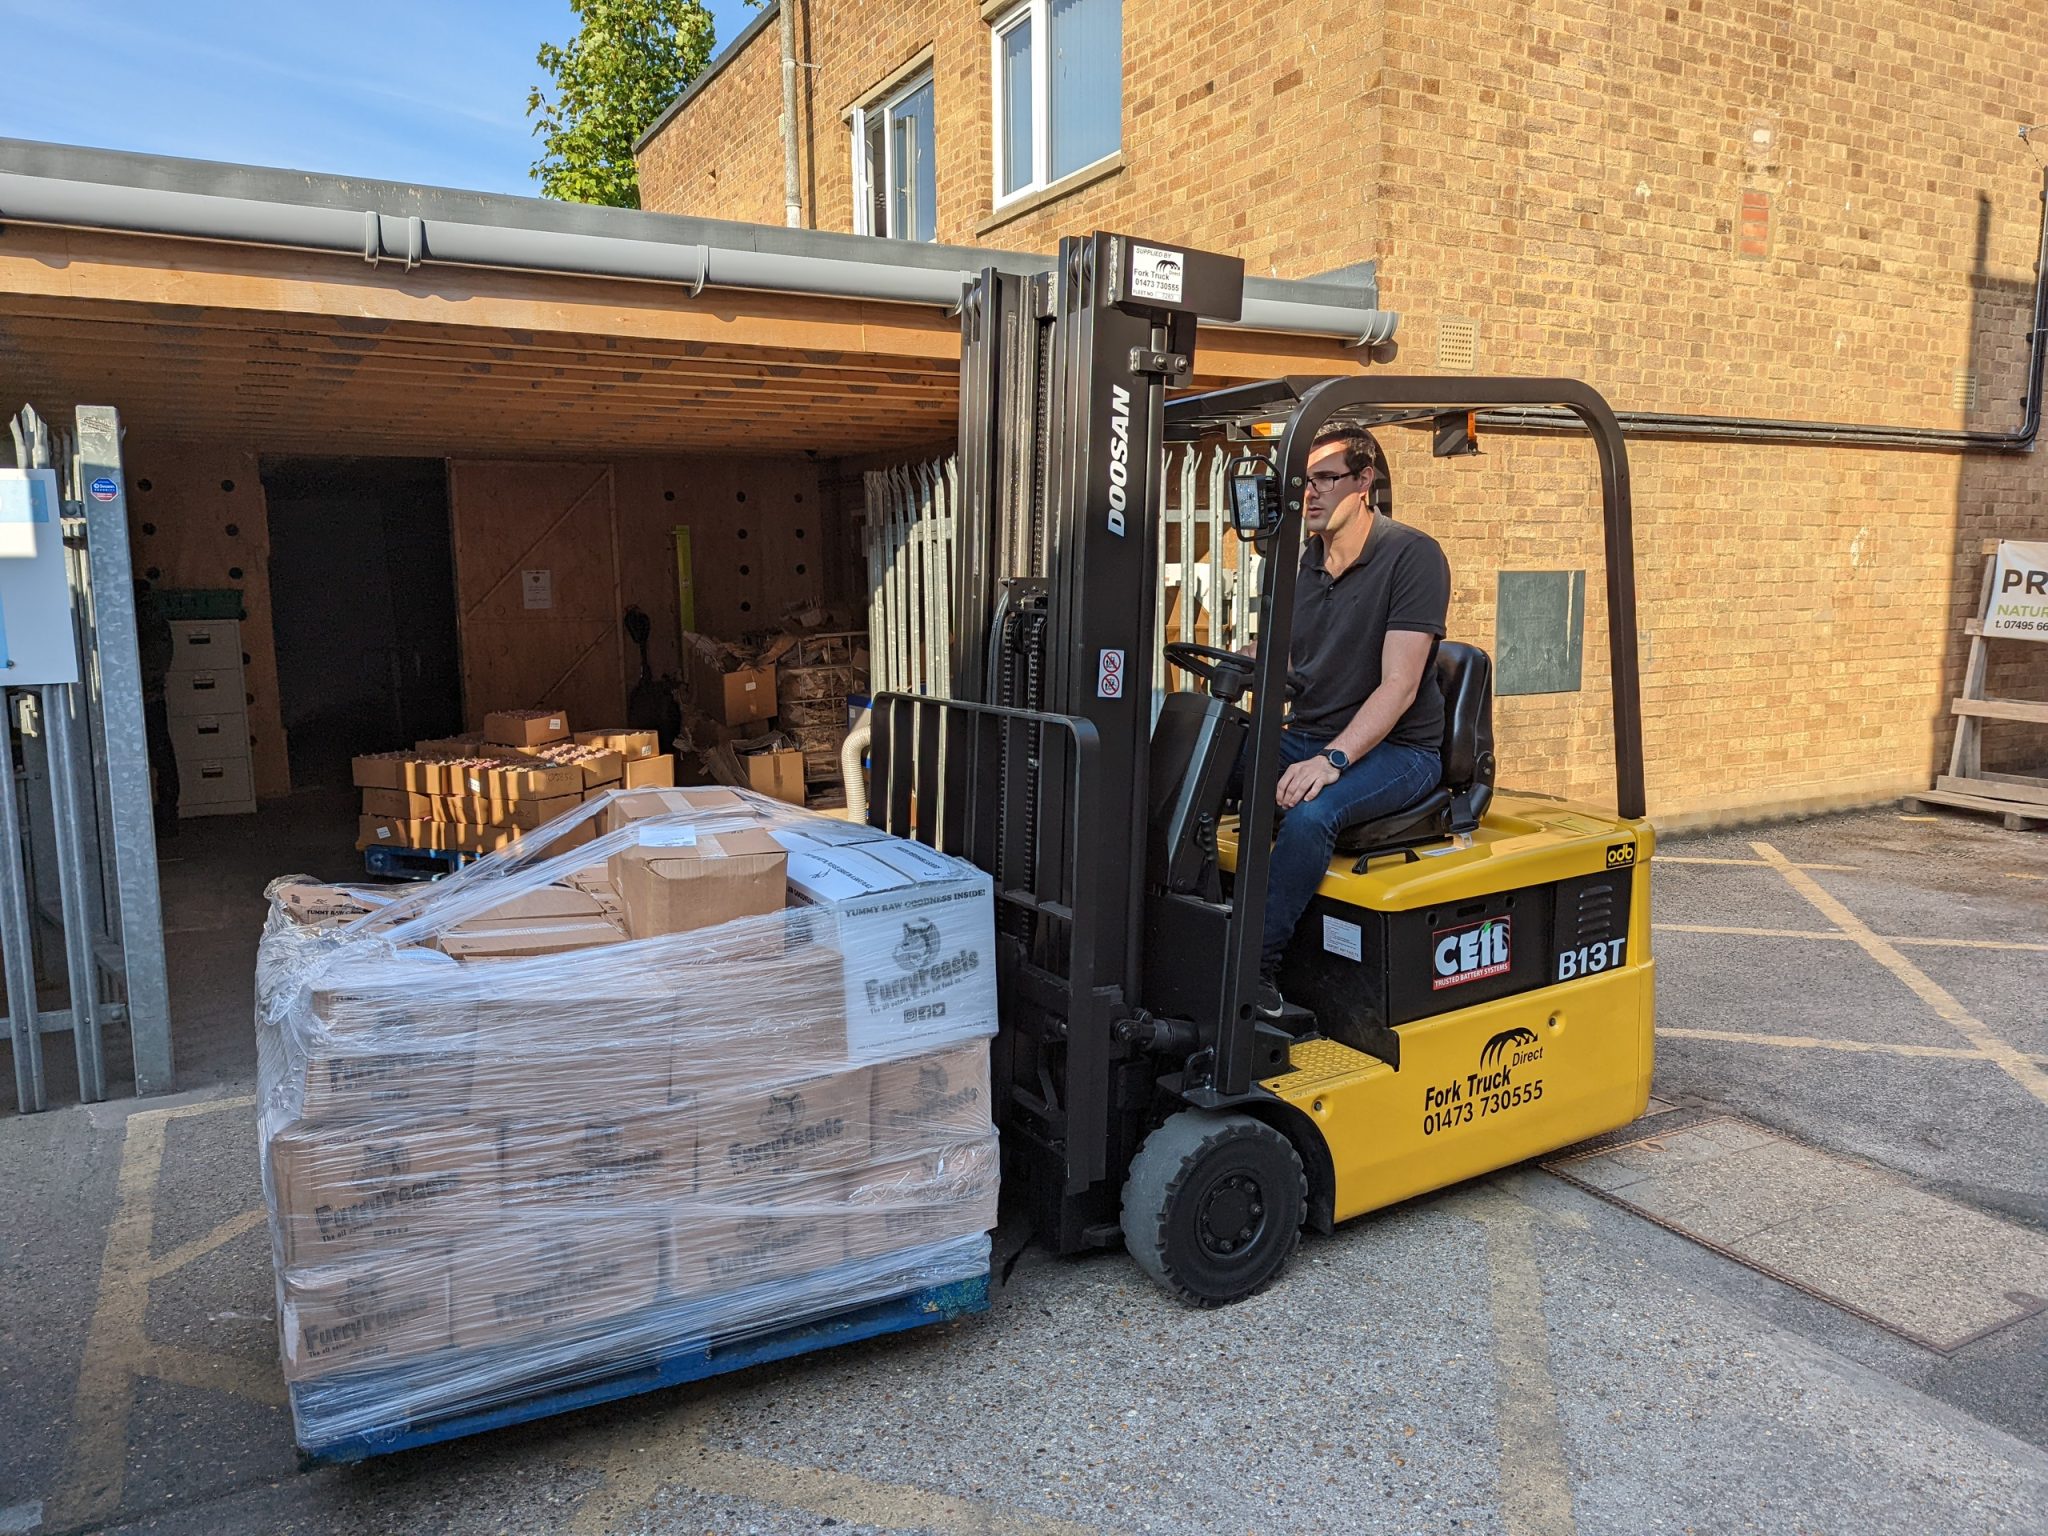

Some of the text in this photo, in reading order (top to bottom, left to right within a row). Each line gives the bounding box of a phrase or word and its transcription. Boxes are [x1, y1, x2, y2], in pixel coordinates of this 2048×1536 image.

[1136, 248, 1163, 257] SUPPLIED
[1133, 268, 1170, 280] Fork Truck
[1135, 278, 1180, 291] 01473 730555
[1107, 384, 1130, 537] DOOSAN
[2004, 620, 2034, 631] 07495
[845, 888, 986, 918] YUMMY RAW GOODNESS INSIDE!
[1557, 937, 1626, 981] B13T
[1435, 963, 1508, 987] TRUSTED BATTERY SYSTEMS
[1512, 1046, 1543, 1067] Direct
[1424, 1064, 1511, 1111] Fork Truck
[1423, 1079, 1543, 1135] 01473 730555
